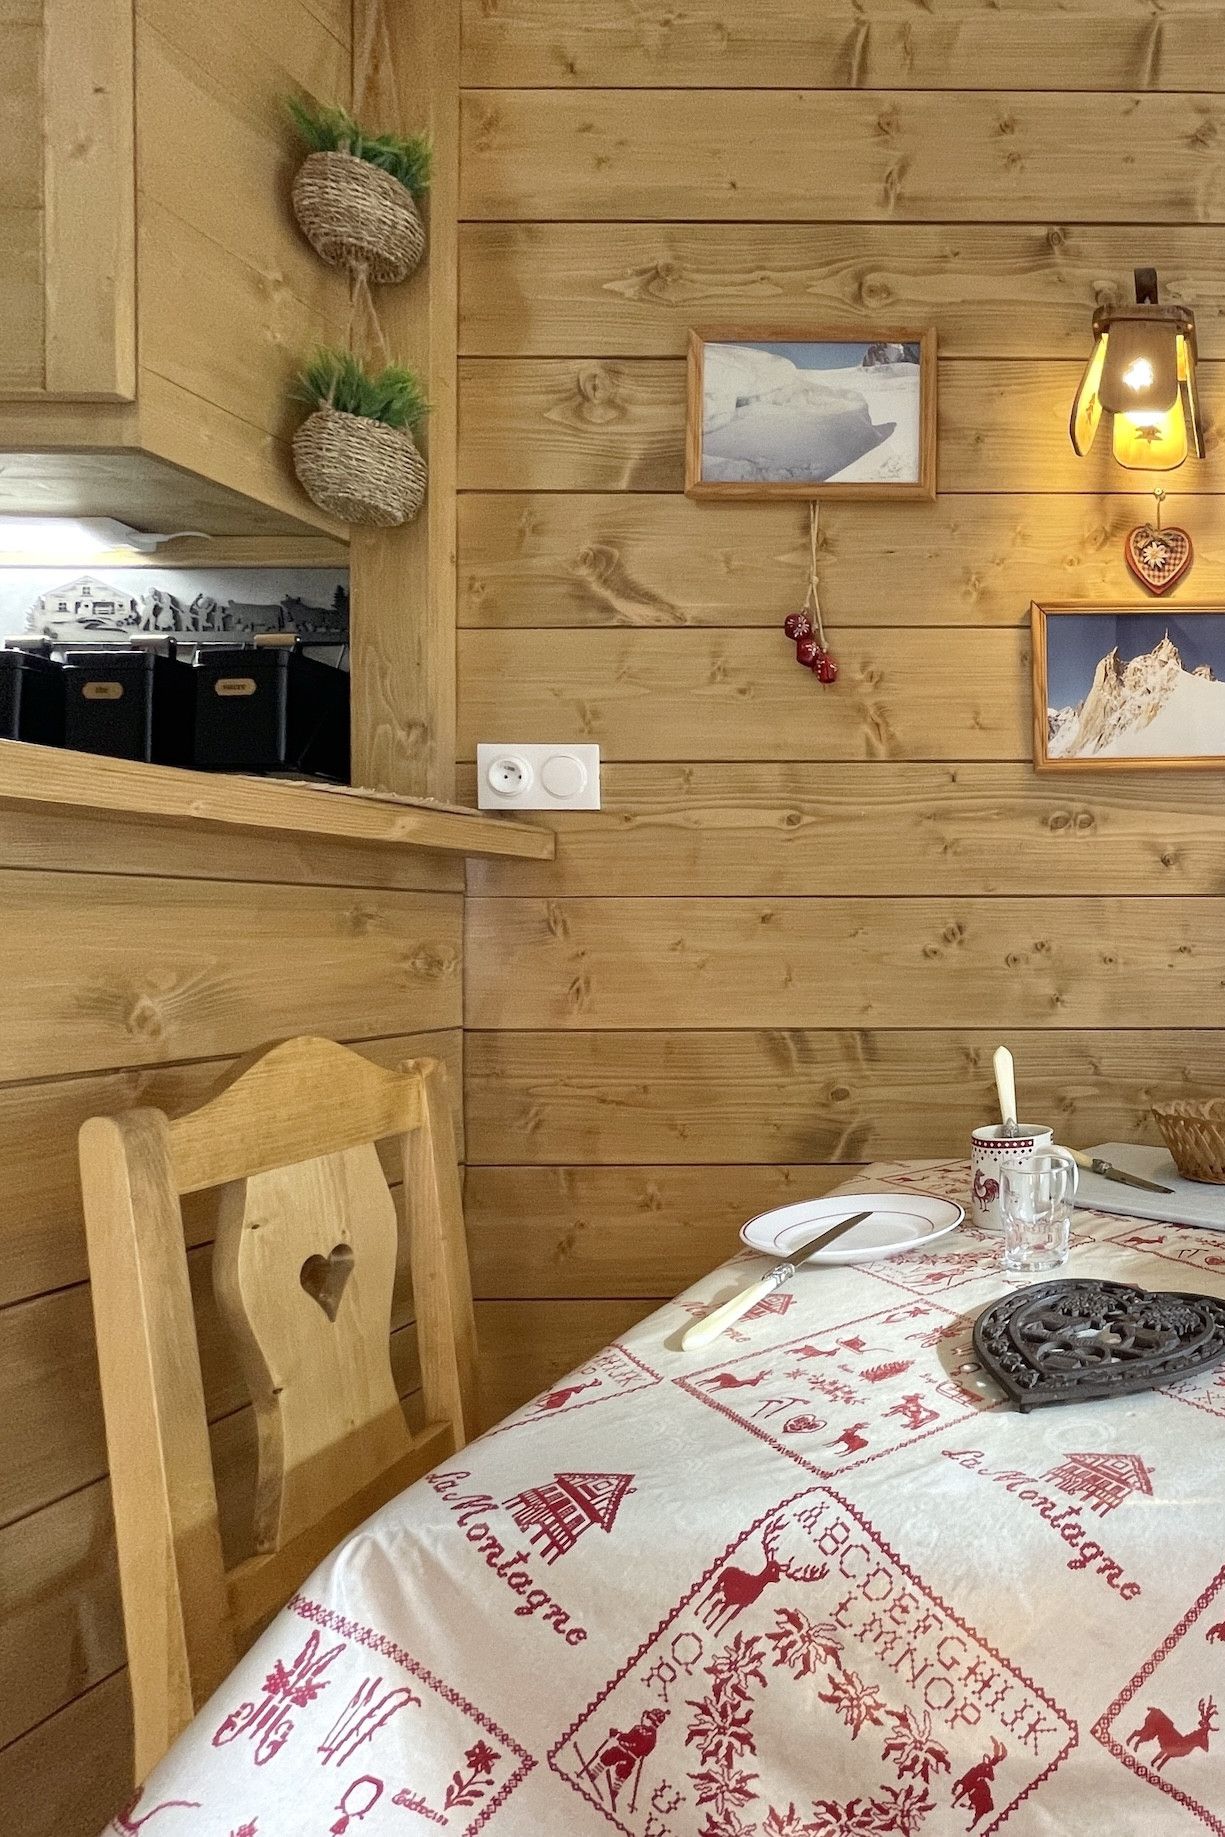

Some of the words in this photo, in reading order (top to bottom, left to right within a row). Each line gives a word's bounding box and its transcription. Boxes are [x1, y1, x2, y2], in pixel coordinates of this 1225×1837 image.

[425, 1471, 471, 1492] La
[941, 1450, 984, 1470] La
[978, 1469, 1141, 1601] Montagne
[442, 1493, 588, 1646] Montagne
